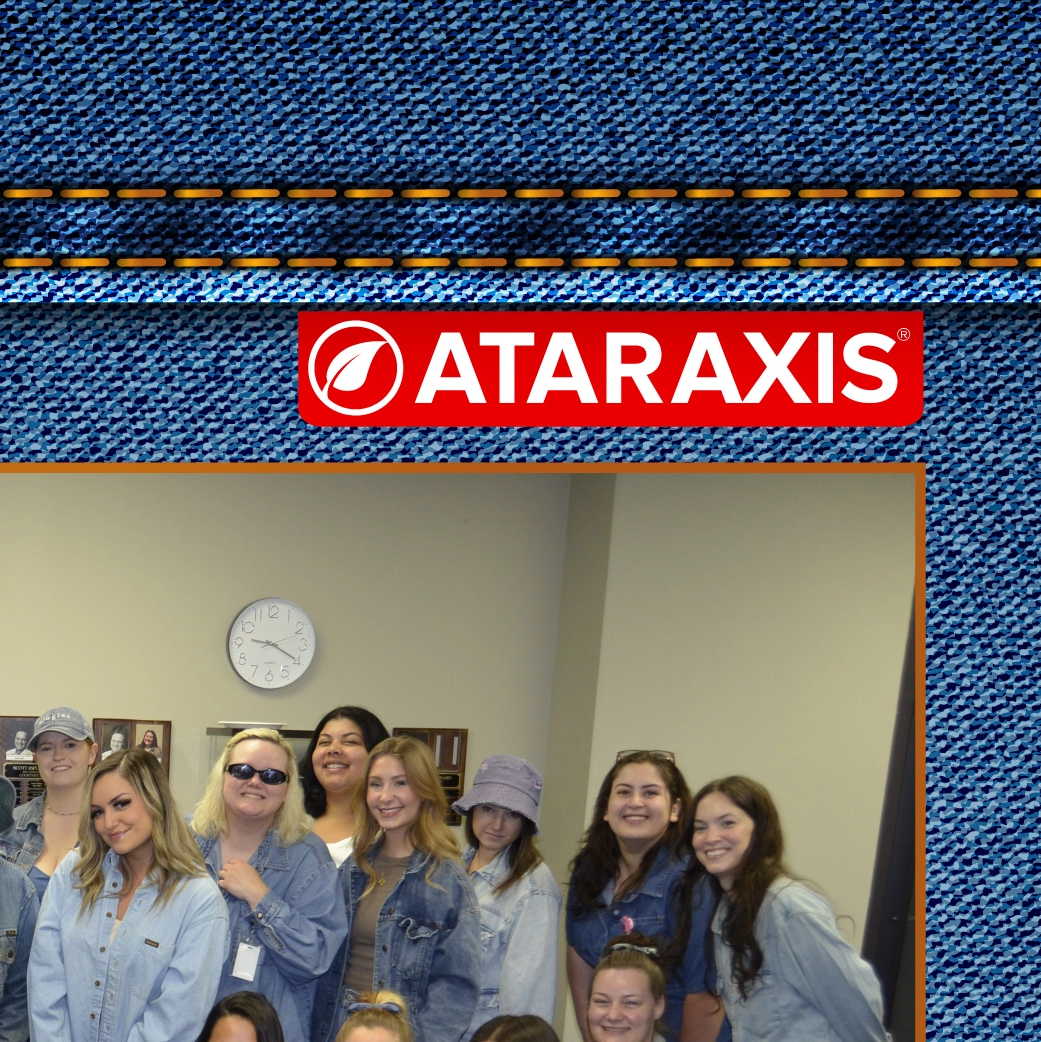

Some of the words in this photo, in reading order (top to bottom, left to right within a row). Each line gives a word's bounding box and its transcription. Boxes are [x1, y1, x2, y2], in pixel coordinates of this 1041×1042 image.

[254, 608, 262, 622] 11
[268, 605, 279, 619] 12
[241, 620, 255, 634] 10
[294, 621, 304, 635] 2
[234, 637, 244, 650] 9
[298, 638, 308, 652] 3
[238, 652, 247, 666] 8
[292, 655, 301, 666] 4
[250, 665, 259, 678] 7
[264, 670, 274, 682] 6
[280, 666, 290, 679] 5
